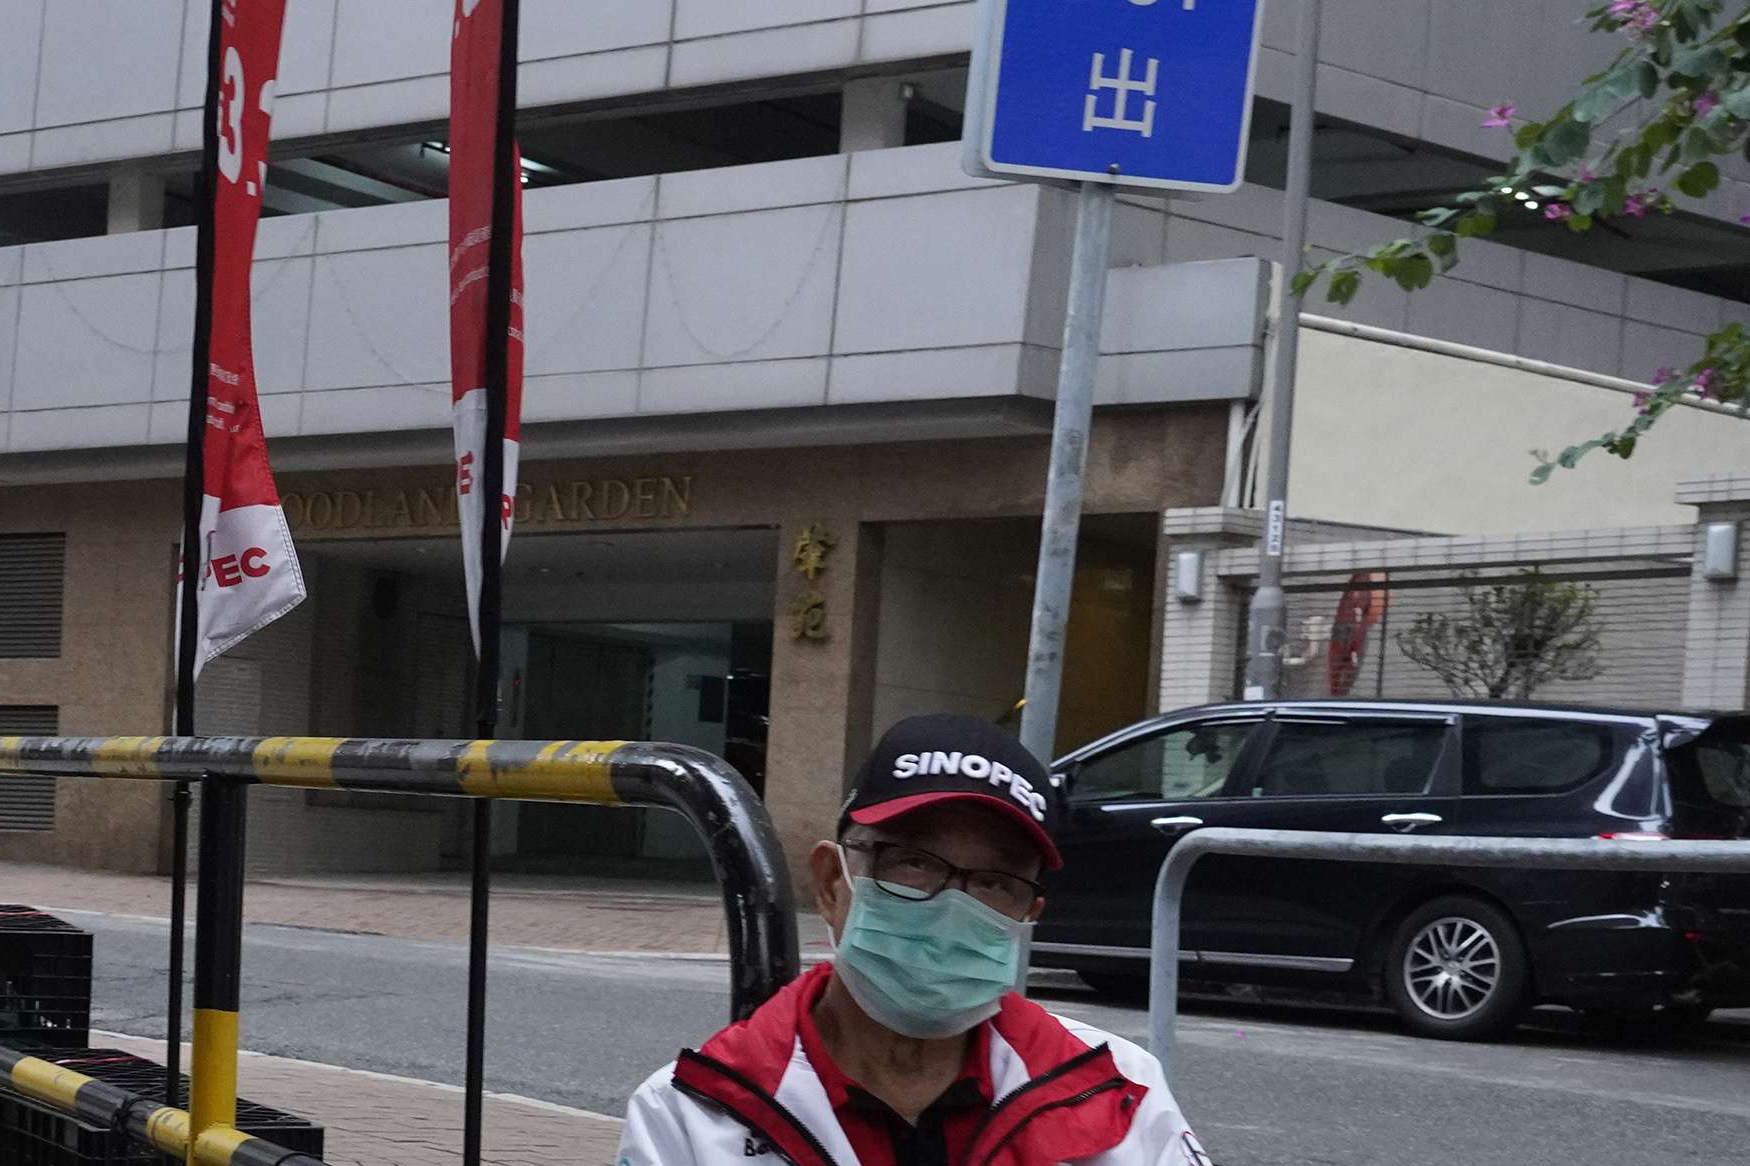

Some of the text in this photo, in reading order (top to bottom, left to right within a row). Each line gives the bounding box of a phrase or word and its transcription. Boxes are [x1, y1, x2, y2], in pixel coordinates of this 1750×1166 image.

[1082, 48, 1159, 138] 出
[282, 488, 458, 530] OODLAN
[514, 476, 693, 525] GARDEN
[892, 750, 1048, 823] SINOPEC
